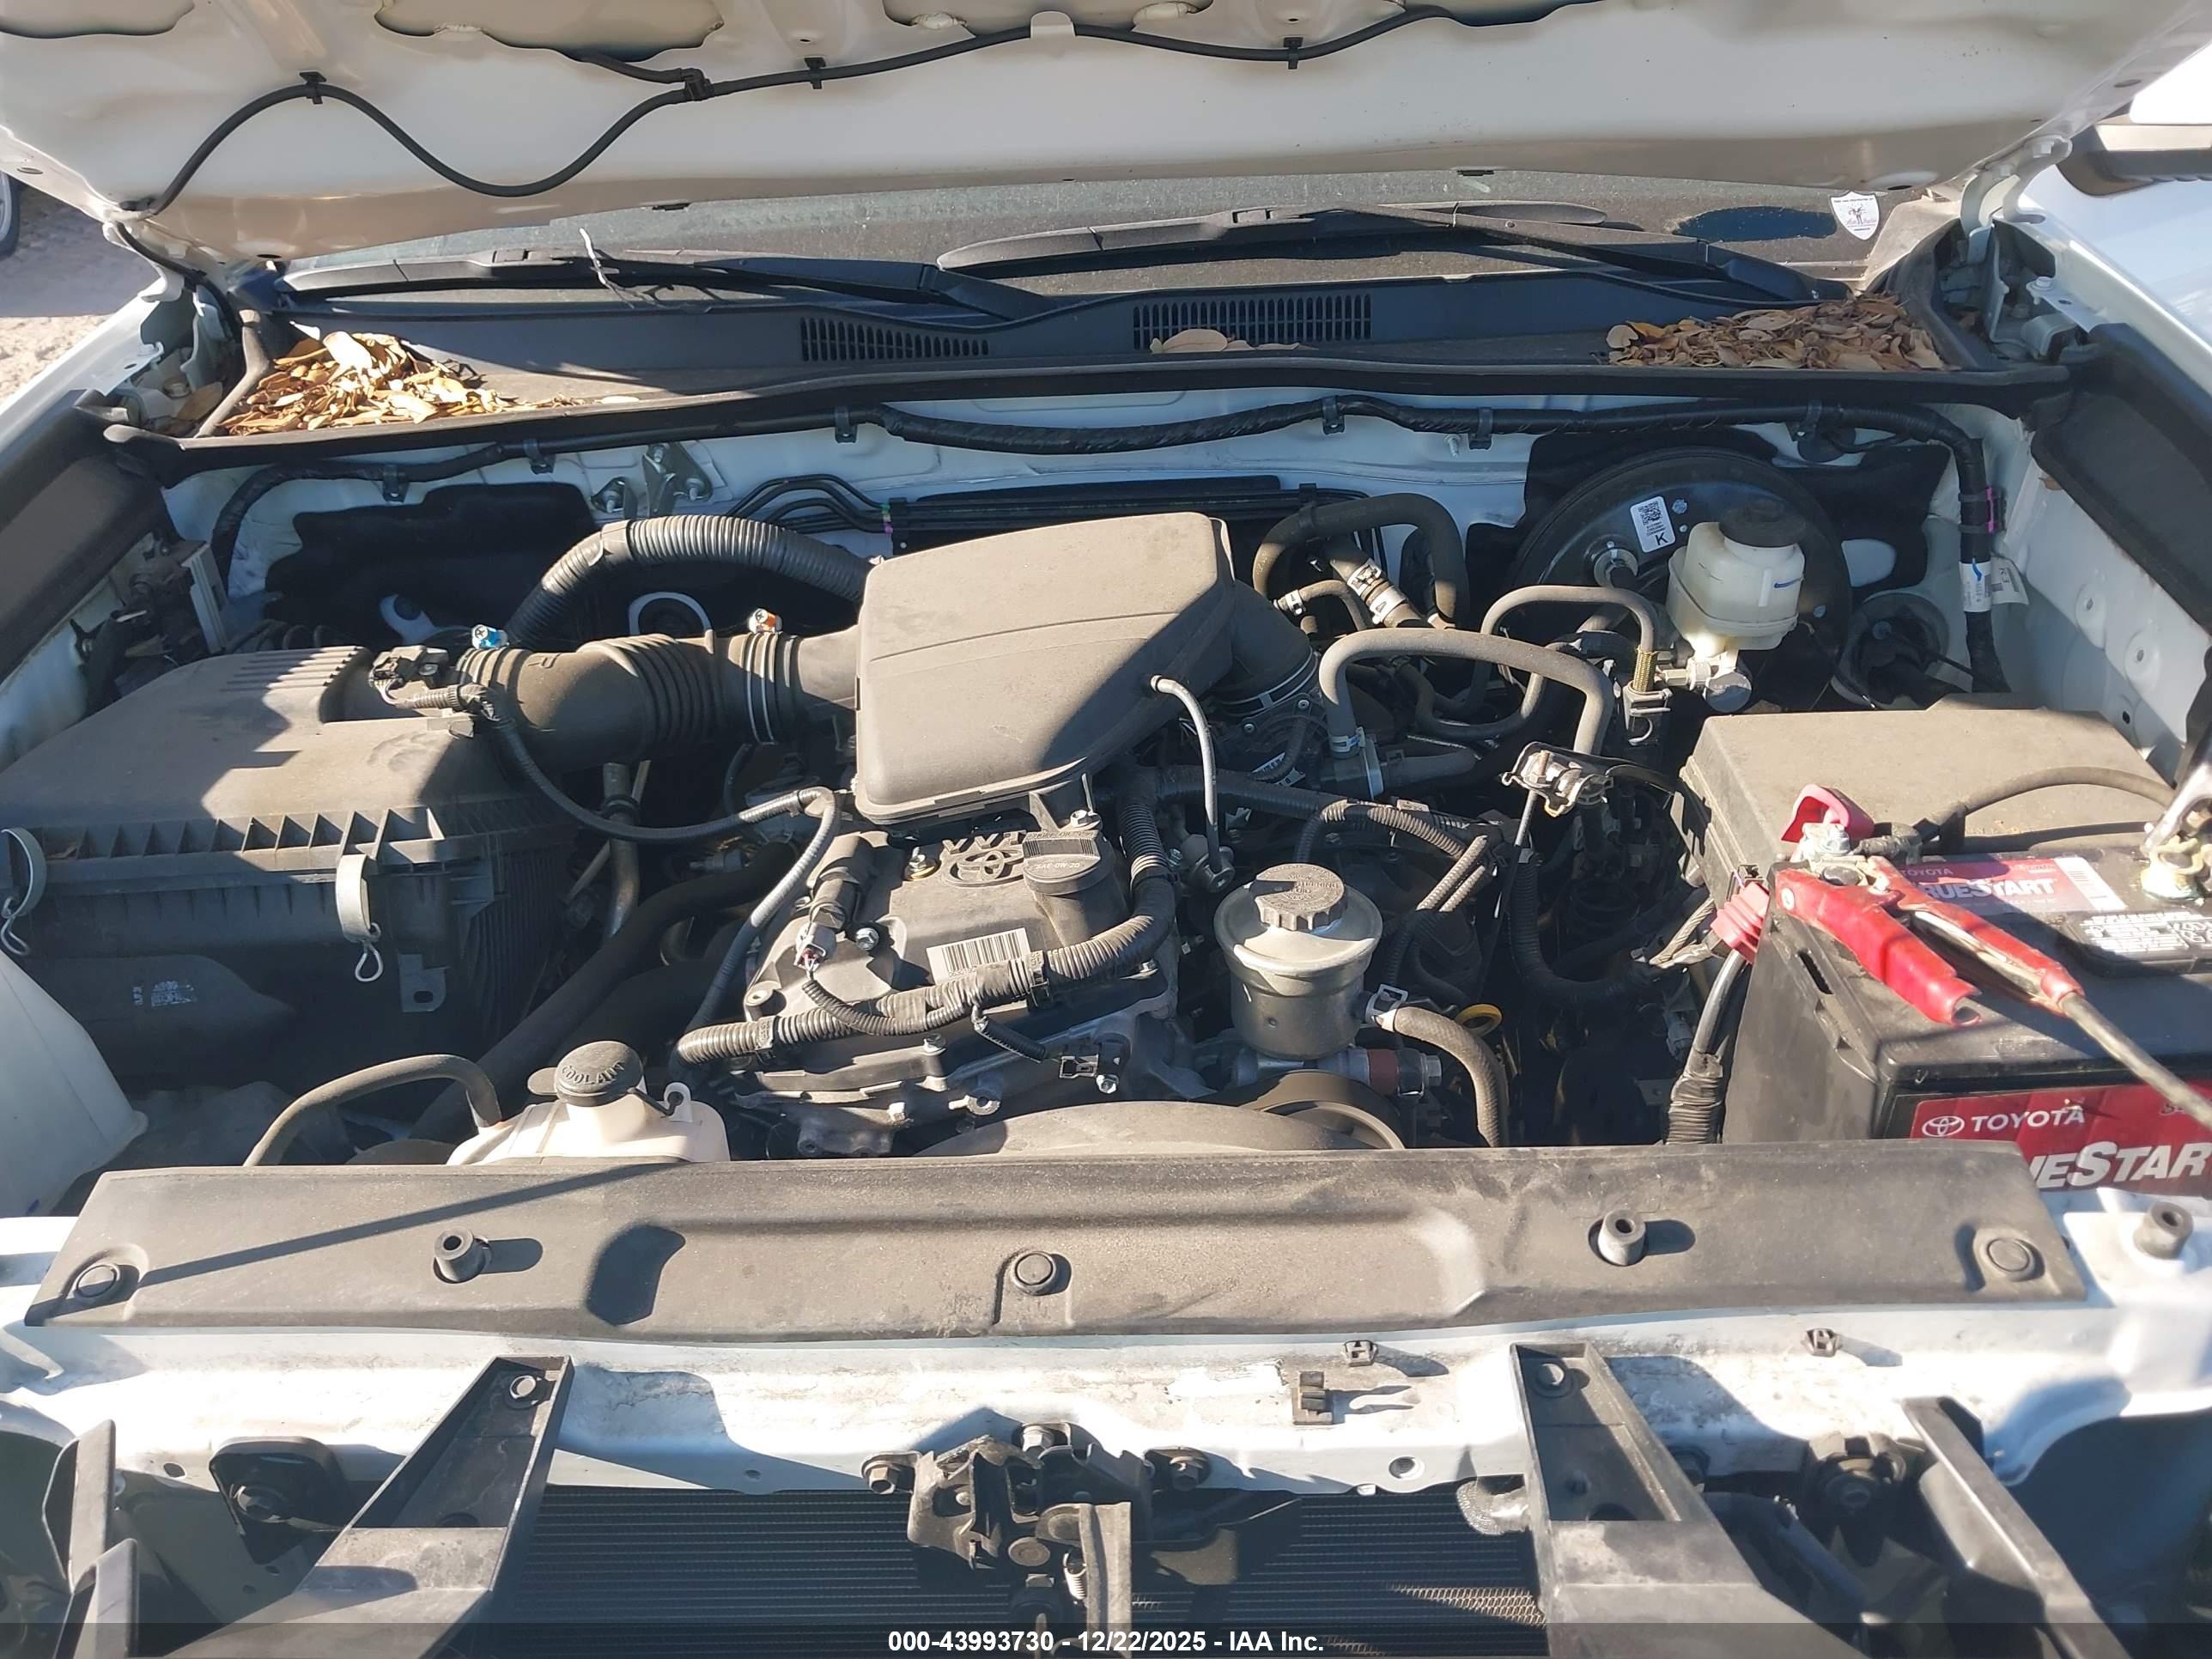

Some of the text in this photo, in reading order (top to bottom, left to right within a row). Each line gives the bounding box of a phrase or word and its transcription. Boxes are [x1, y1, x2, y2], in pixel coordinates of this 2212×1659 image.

[1656, 532, 1668, 546] K
[1898, 868, 1954, 877] TOYOTA
[1917, 879, 2055, 899] RUESTART
[562, 1060, 626, 1085] COOLANT
[1971, 1109, 2086, 1133] TOYOTA
